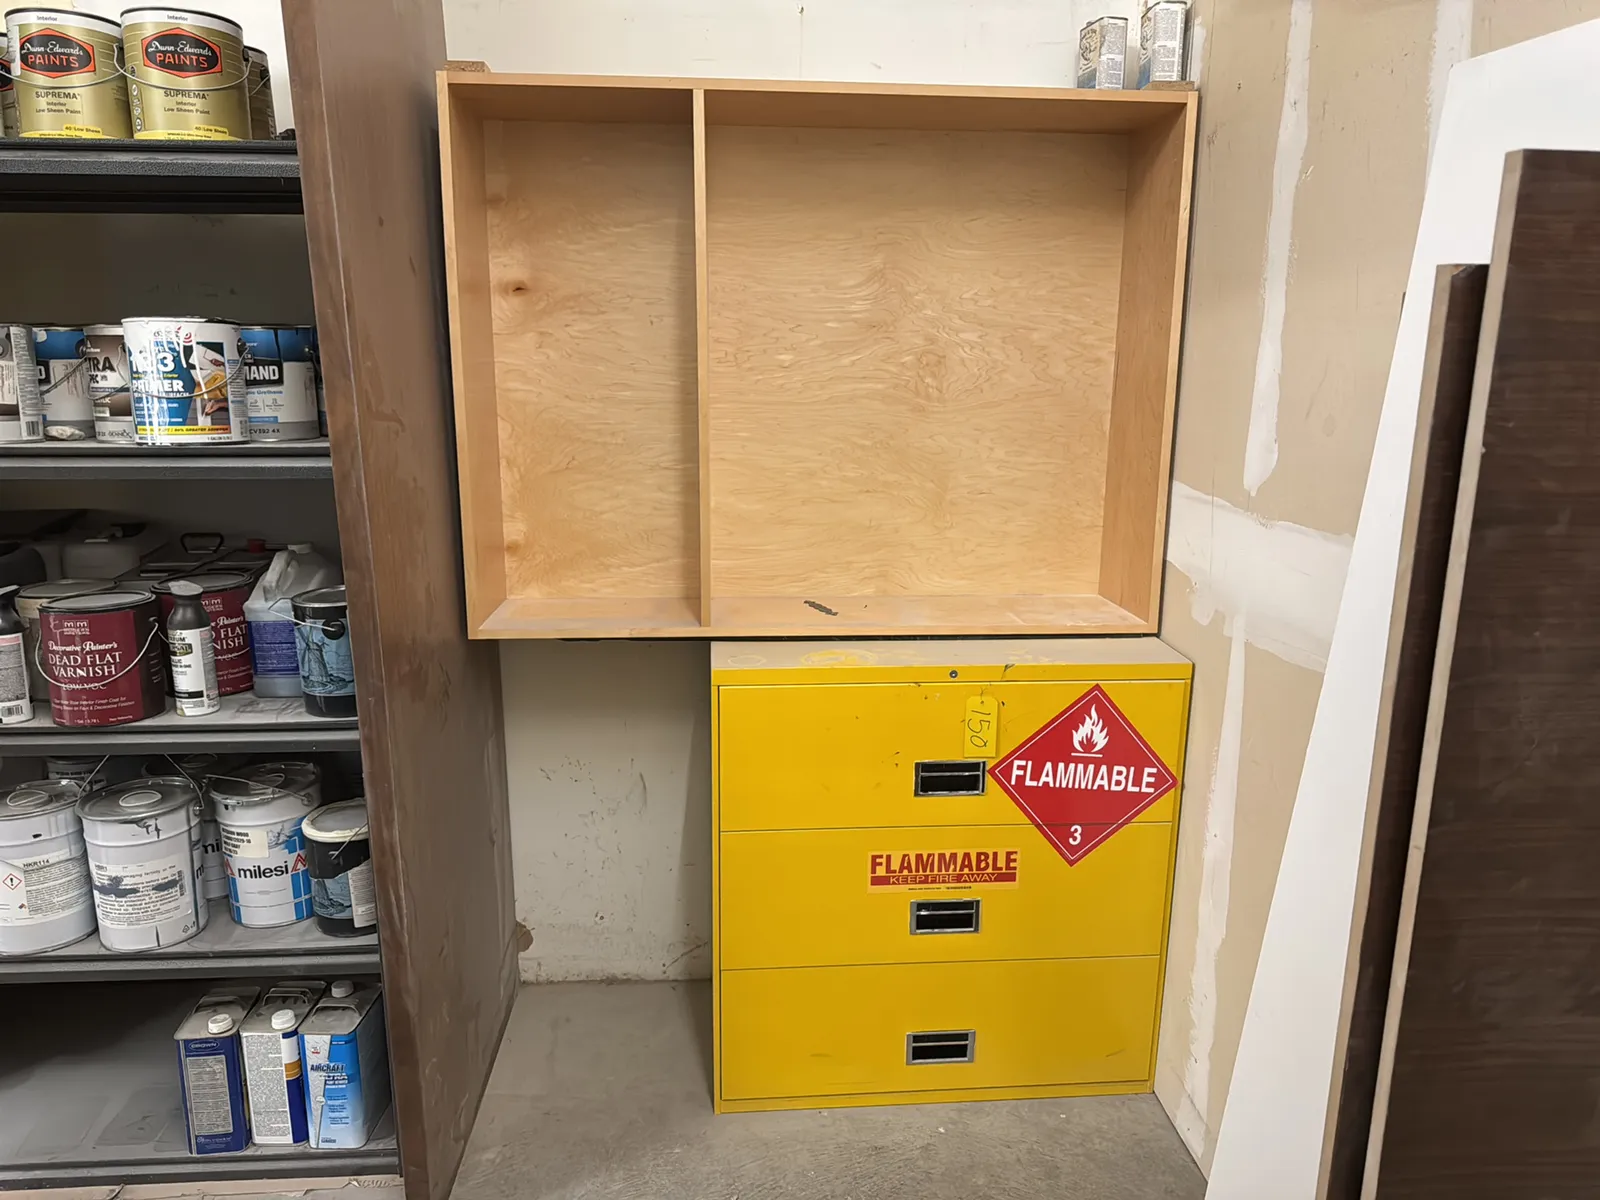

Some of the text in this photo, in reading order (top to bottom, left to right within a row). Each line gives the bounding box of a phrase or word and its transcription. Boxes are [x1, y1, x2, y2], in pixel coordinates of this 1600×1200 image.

[21, 41, 84, 55] Dunn-Edwards
[148, 41, 212, 56] Dunn-Edwards
[28, 55, 79, 67] PAINTS
[155, 53, 208, 67] PAINTS
[221, 624, 248, 639] FLAT
[48, 640, 118, 653] Decorative Painter's
[49, 652, 122, 666] DEAD FLAT
[53, 664, 116, 678] VARNISH
[967, 709, 991, 748] 150
[1011, 759, 1157, 793] FLAMMABLE
[1069, 825, 1081, 845] 3
[238, 861, 289, 879] milesi
[870, 851, 1018, 875] FLAMMABLE
[890, 873, 998, 884] KEEP FIRE AWAY
[310, 1062, 344, 1072] AIRCRAFT
